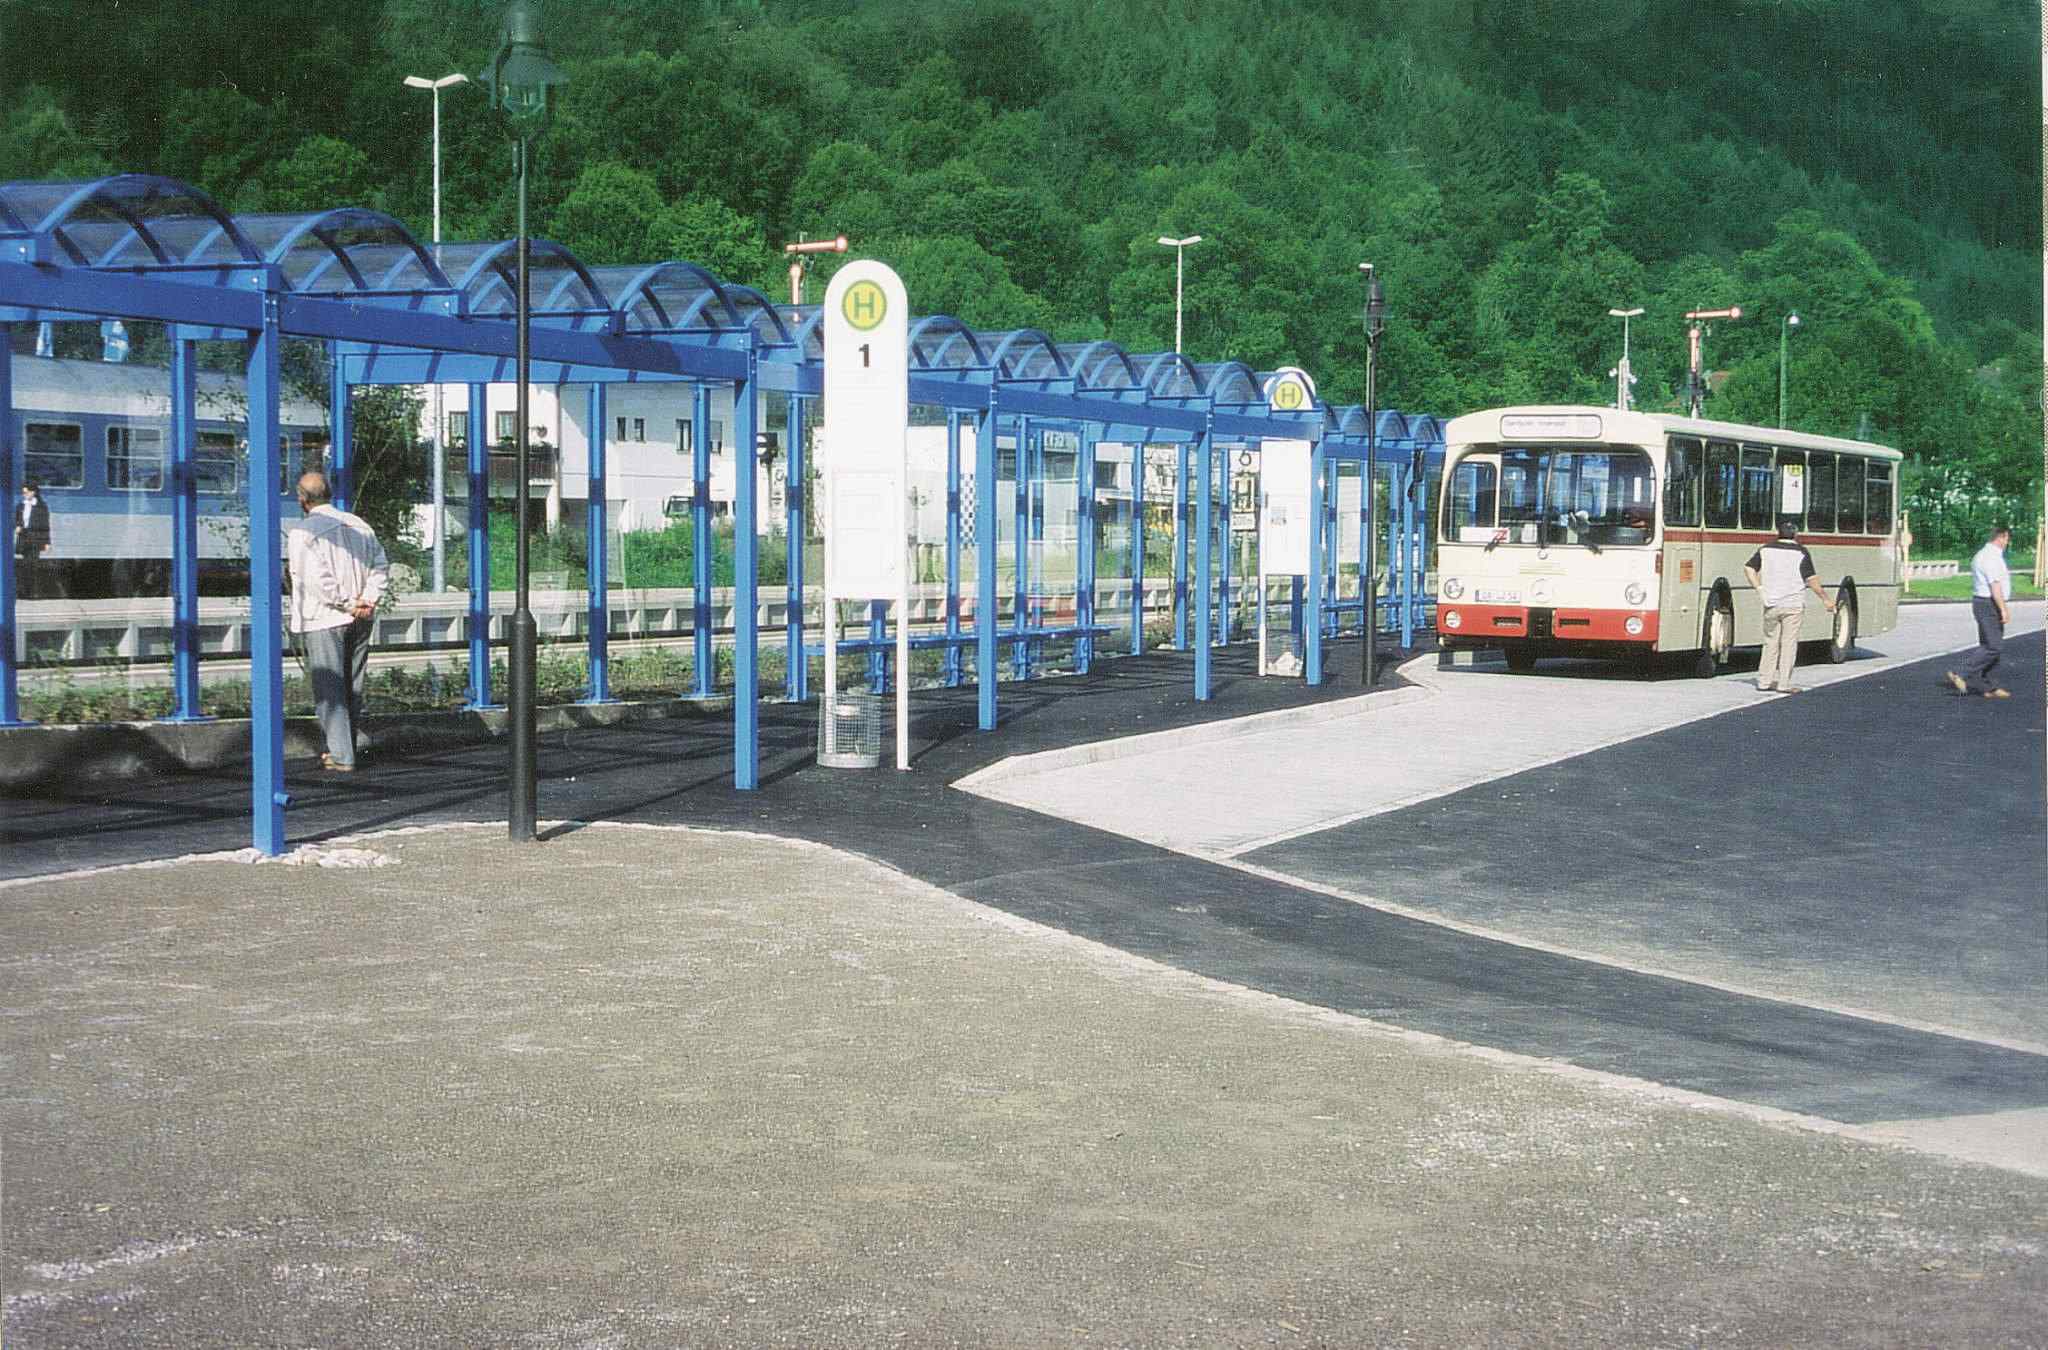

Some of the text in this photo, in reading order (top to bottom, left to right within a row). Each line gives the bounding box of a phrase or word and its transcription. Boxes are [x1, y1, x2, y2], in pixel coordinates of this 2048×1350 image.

[853, 291, 875, 319] H
[858, 343, 870, 368] 1
[1281, 387, 1296, 404] H
[1234, 480, 1252, 509] H
